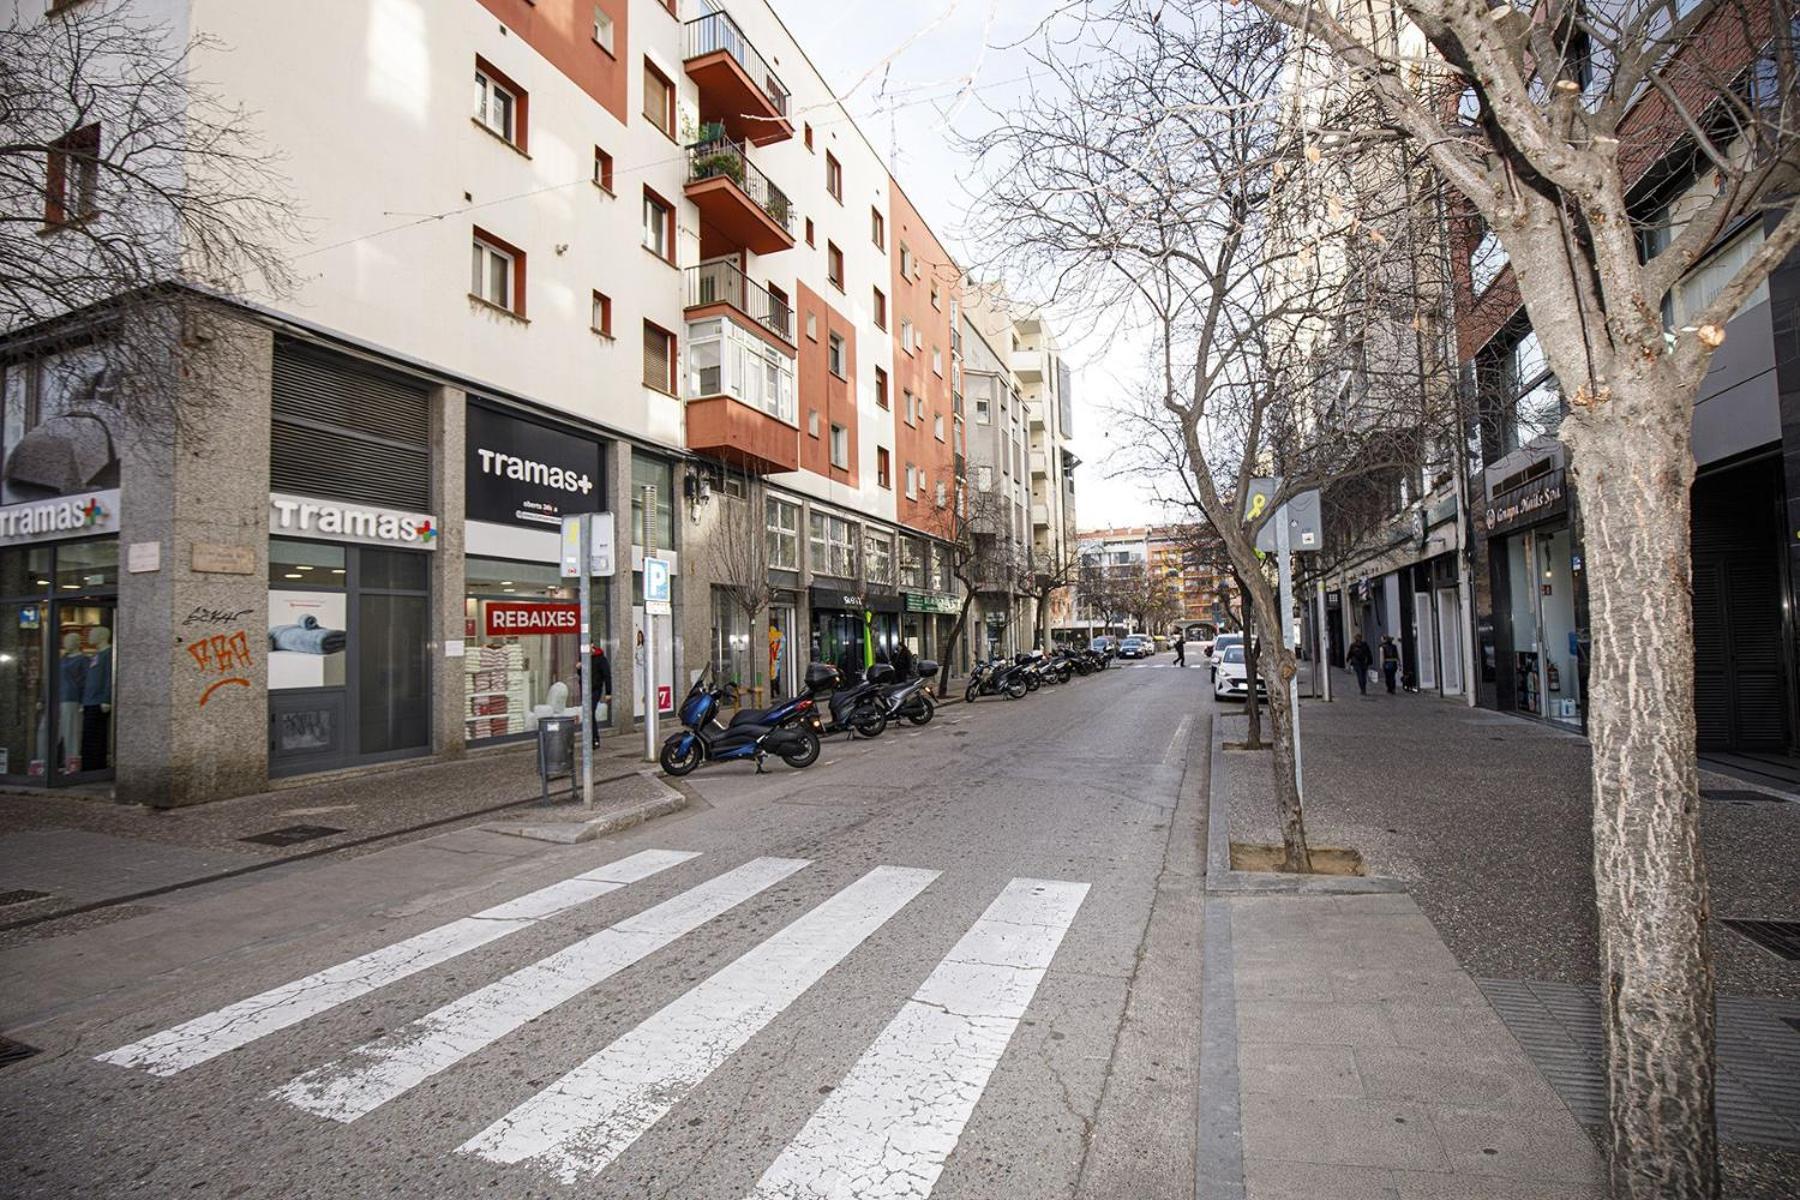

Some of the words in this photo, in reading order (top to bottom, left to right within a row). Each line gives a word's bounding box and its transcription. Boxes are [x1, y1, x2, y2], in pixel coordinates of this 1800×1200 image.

[478, 448, 593, 494] Tramas+
[650, 562, 667, 597] P
[493, 610, 577, 628] REBAIXES
